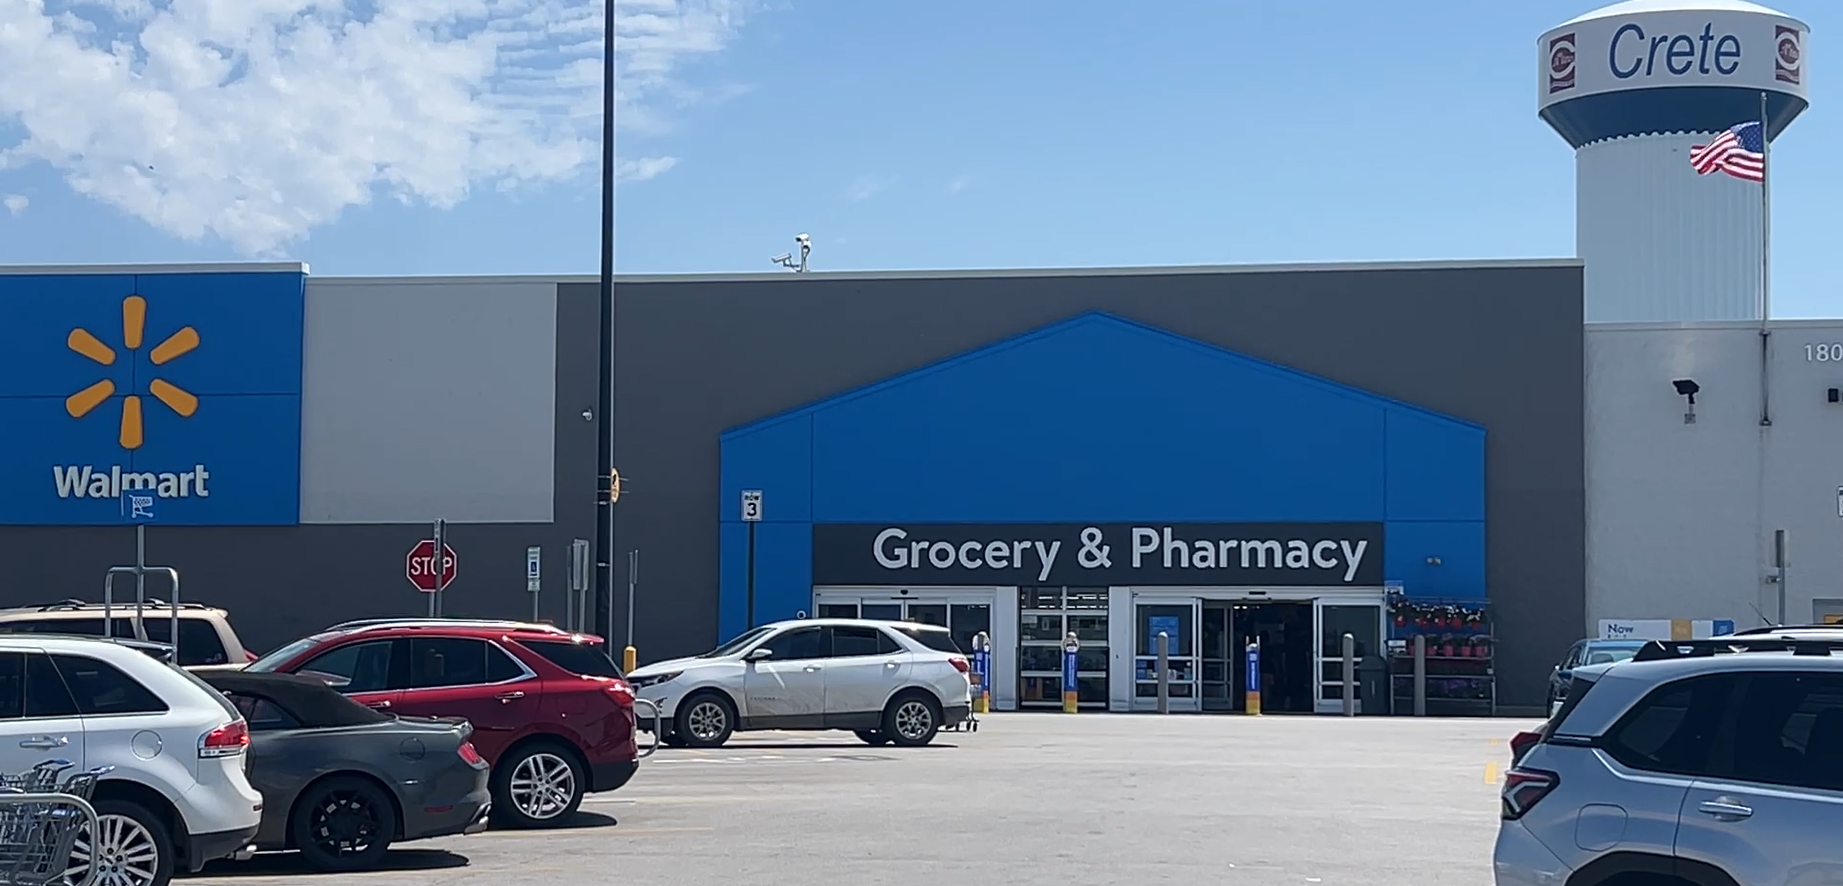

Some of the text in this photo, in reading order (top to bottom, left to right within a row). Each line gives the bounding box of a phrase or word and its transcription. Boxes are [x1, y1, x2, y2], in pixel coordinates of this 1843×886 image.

[1609, 22, 1741, 79] Crete
[1804, 343, 1843, 361] 180
[53, 465, 209, 498] Walmart
[747, 502, 757, 517] 3
[873, 527, 1368, 582] Grocery & Pharmacy
[1607, 624, 1634, 634] Now
